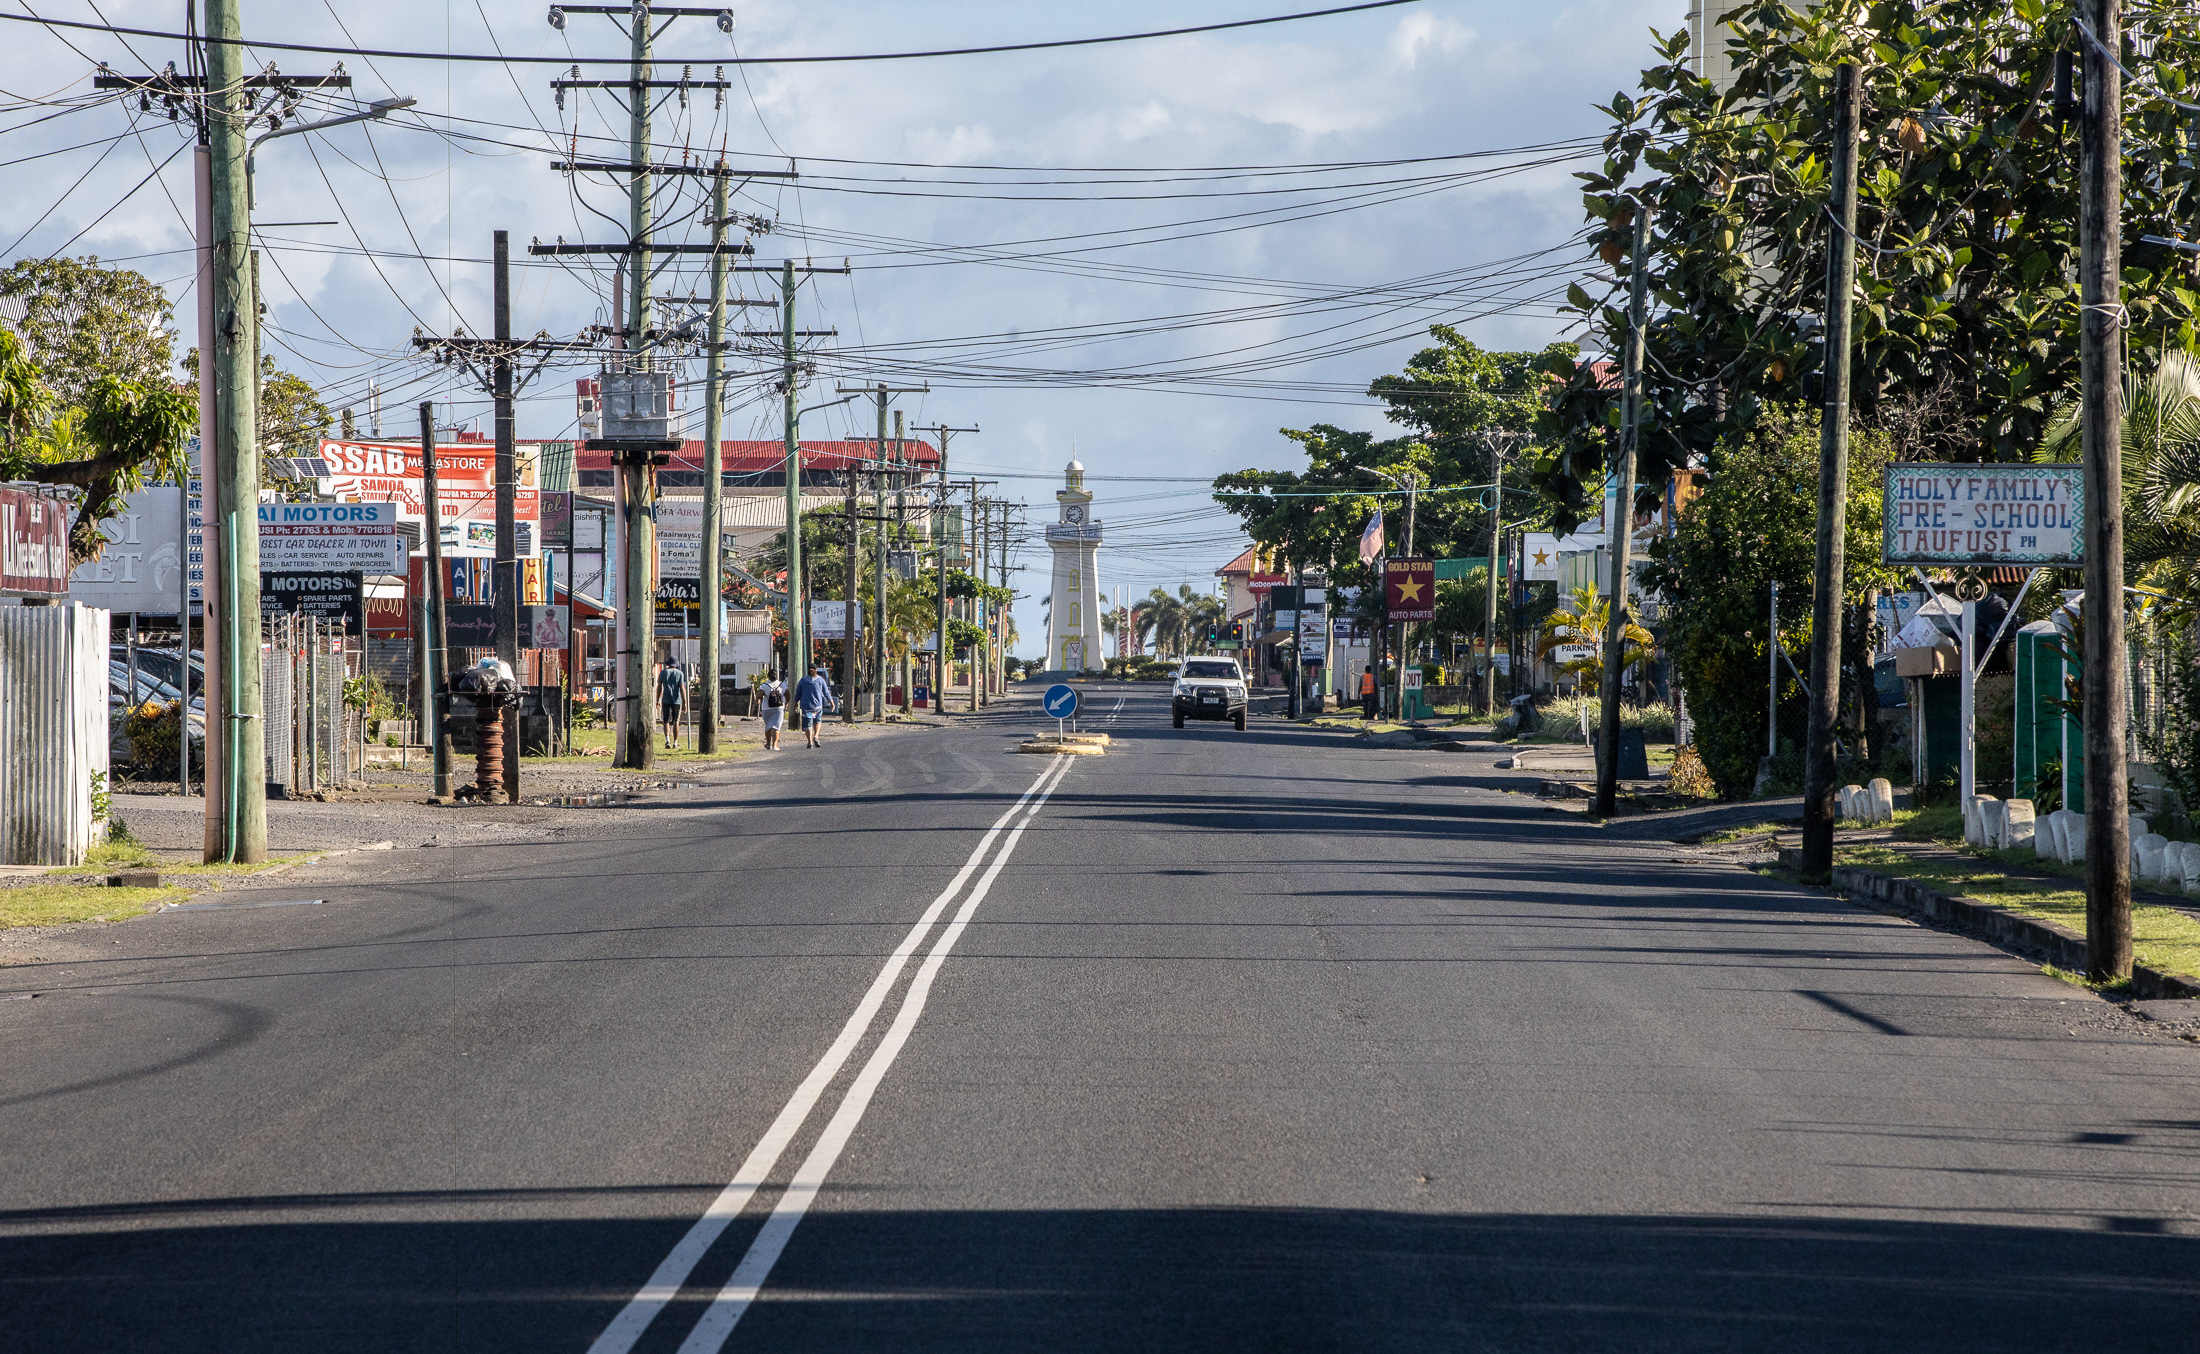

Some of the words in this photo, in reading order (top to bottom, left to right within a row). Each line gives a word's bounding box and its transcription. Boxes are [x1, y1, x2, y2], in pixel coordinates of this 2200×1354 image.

[324, 444, 406, 474] SSAB
[407, 456, 486, 470] MEASTORE
[361, 479, 404, 492] SAMOA
[1899, 478, 1962, 499] HOLY
[1967, 478, 2059, 500] FAMILY
[403, 488, 419, 504] &
[284, 507, 378, 521] MOTORS
[442, 505, 458, 515] LTD
[473, 506, 496, 516] Simpl
[1974, 503, 2071, 528] SCHOOL
[332, 526, 354, 534] Mob:
[261, 540, 283, 548] BEST
[286, 540, 305, 549] CAR
[307, 539, 344, 548] DEALER
[347, 539, 356, 548] IN
[360, 539, 387, 548] TOWN
[1898, 530, 2012, 552] TAUFUSI
[2020, 536, 2036, 548] PH
[1388, 563, 1409, 572] GOLD
[1411, 562, 1432, 572] STAR
[272, 578, 344, 590] MOTORS
[656, 583, 698, 598] aria's
[1389, 611, 1408, 619] AUTO
[1410, 610, 1432, 619] PARTS
[1406, 673, 1422, 686] OUT
